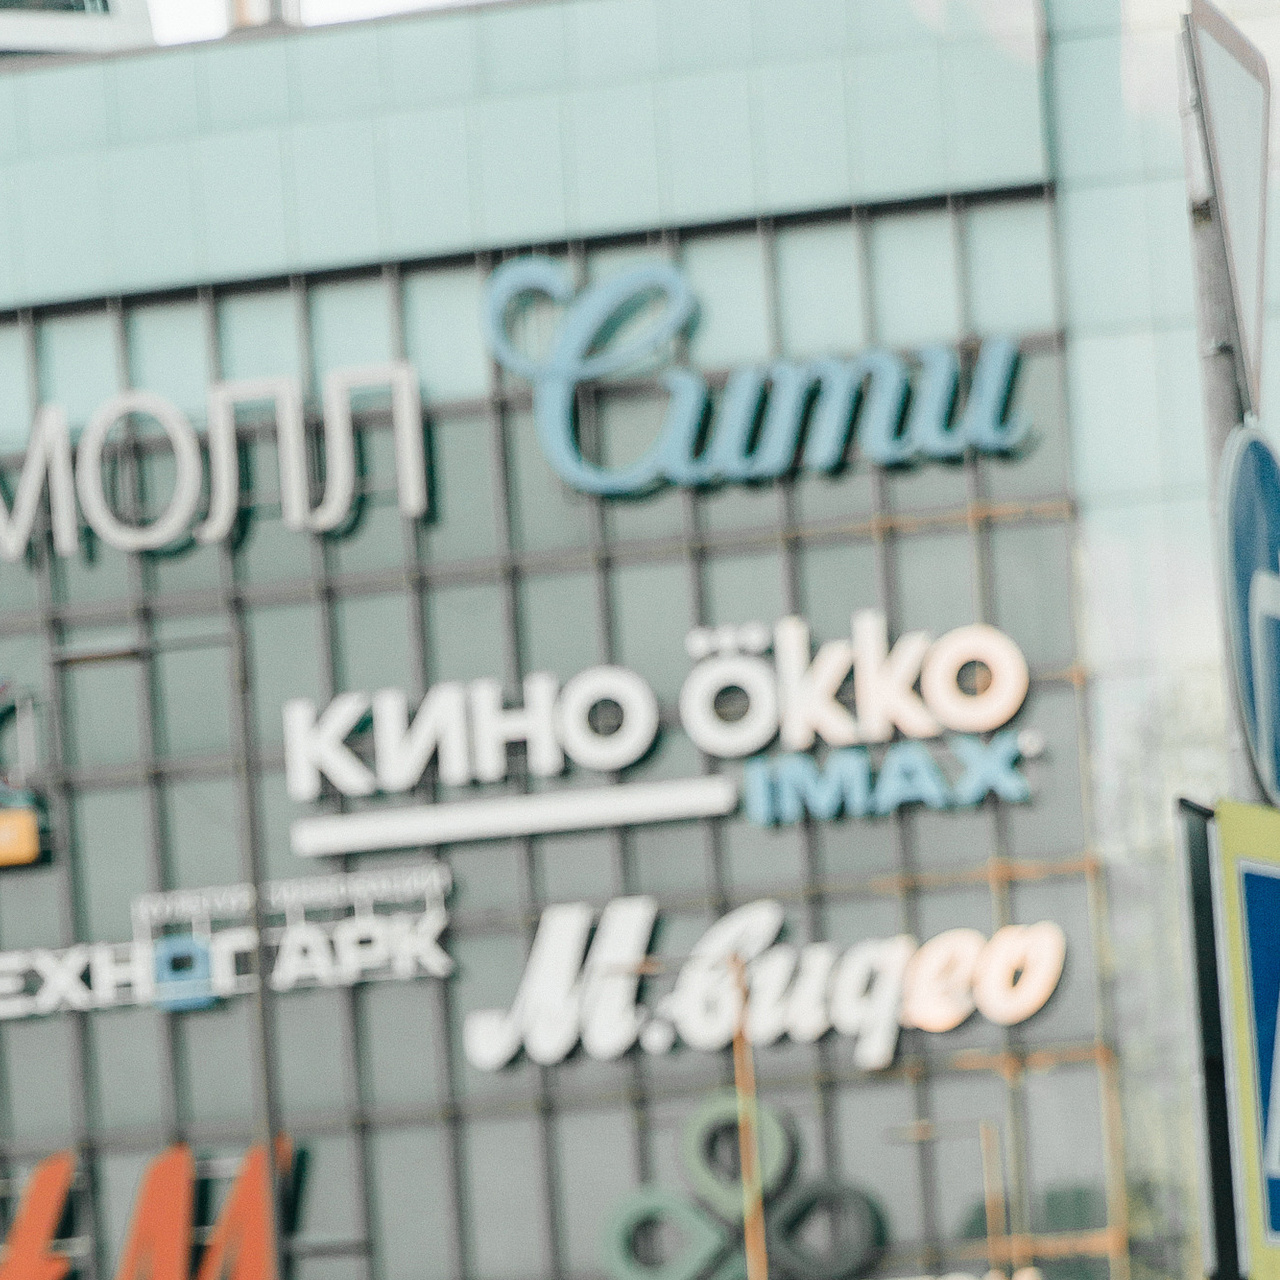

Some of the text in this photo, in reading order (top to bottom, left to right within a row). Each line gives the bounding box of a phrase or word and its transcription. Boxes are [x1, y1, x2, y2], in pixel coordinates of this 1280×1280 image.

[484, 254, 1033, 497] Сити
[282, 664, 660, 802] КИНО
[747, 734, 1033, 828] IMAX
